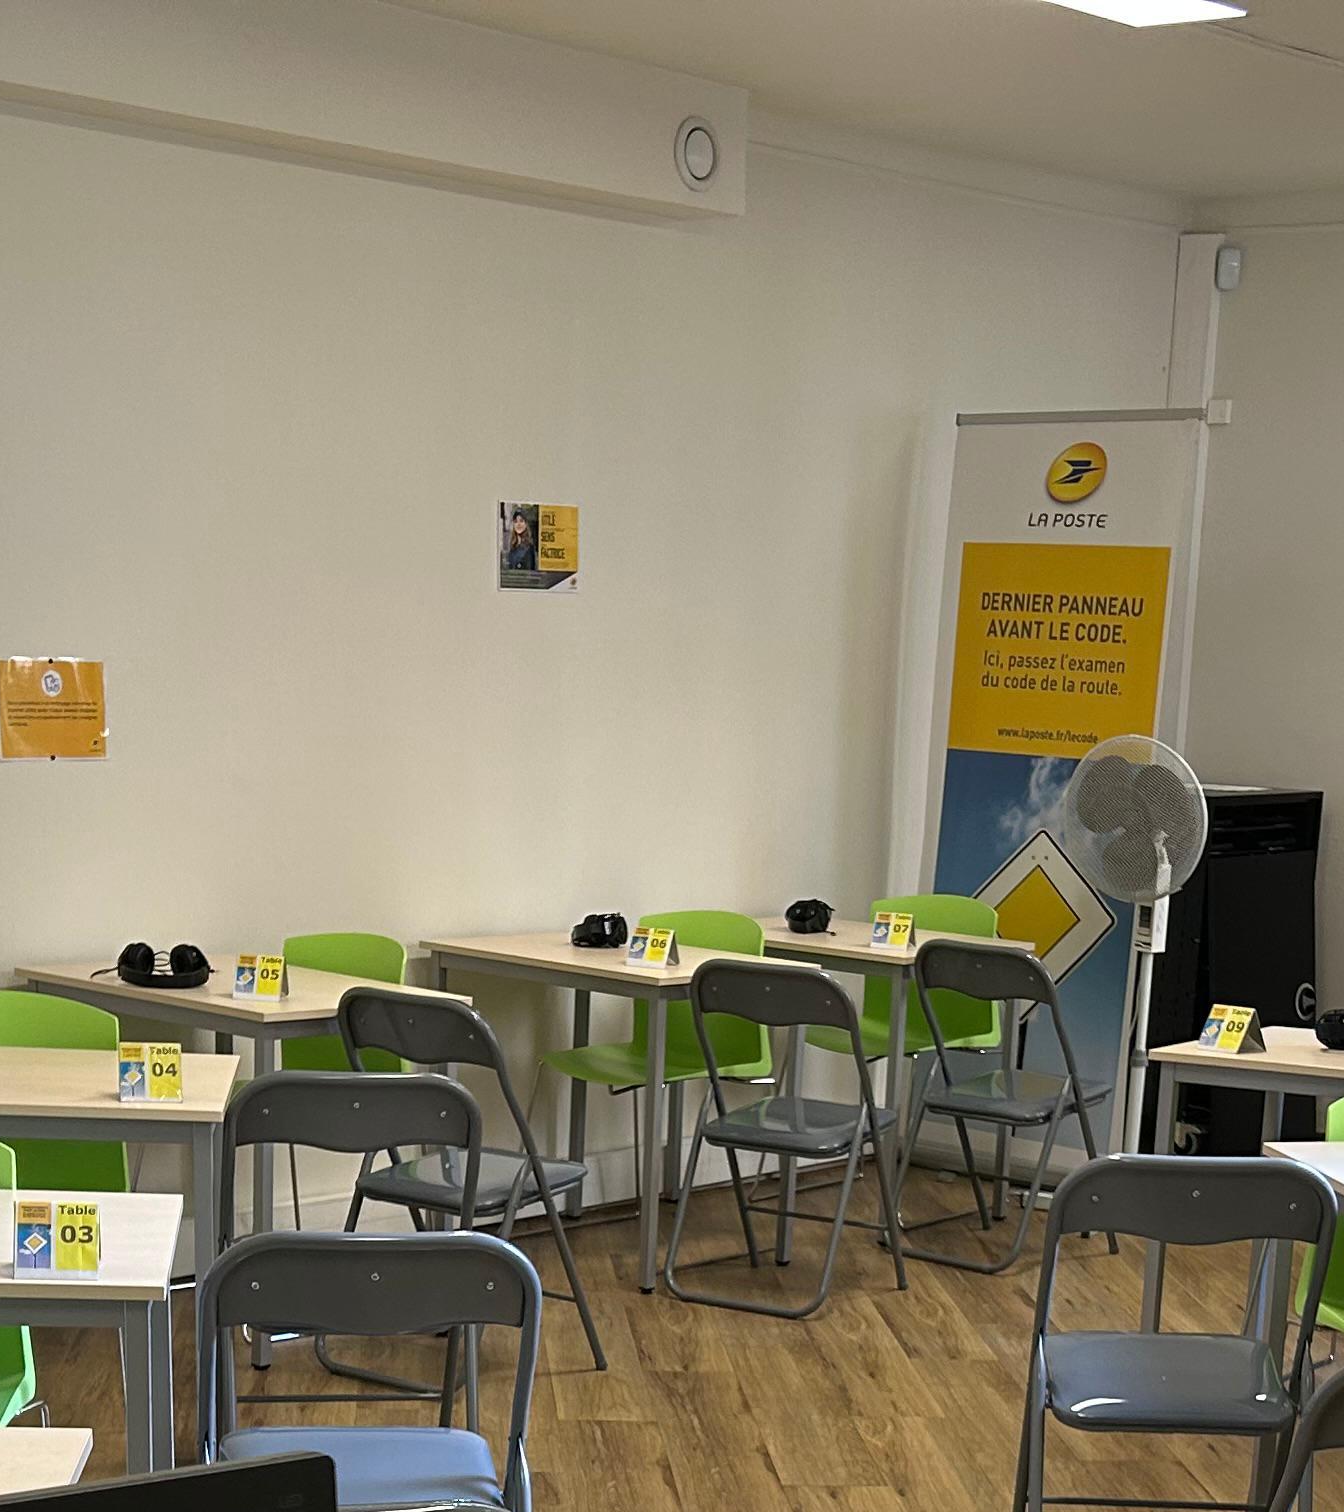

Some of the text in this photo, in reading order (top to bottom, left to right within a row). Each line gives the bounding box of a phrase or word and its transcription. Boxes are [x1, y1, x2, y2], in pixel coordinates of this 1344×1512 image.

[1027, 512, 1108, 529] LA POSTE
[981, 592, 1144, 617] DERNIER PANNEAU
[987, 619, 1127, 644] AVANT LE CODE.
[984, 650, 1125, 674] Ici, passez l'examen
[981, 671, 1122, 696] du code de la route.
[997, 727, 1098, 744] www.laposte.fr/lecode
[893, 924, 909, 933] 07
[651, 938, 667, 948] 06
[260, 968, 280, 981] 05
[1226, 1020, 1245, 1033] 09
[150, 1046, 179, 1055] Table
[152, 1062, 178, 1078] 04
[58, 1205, 96, 1216] Table
[60, 1225, 94, 1243] 03
